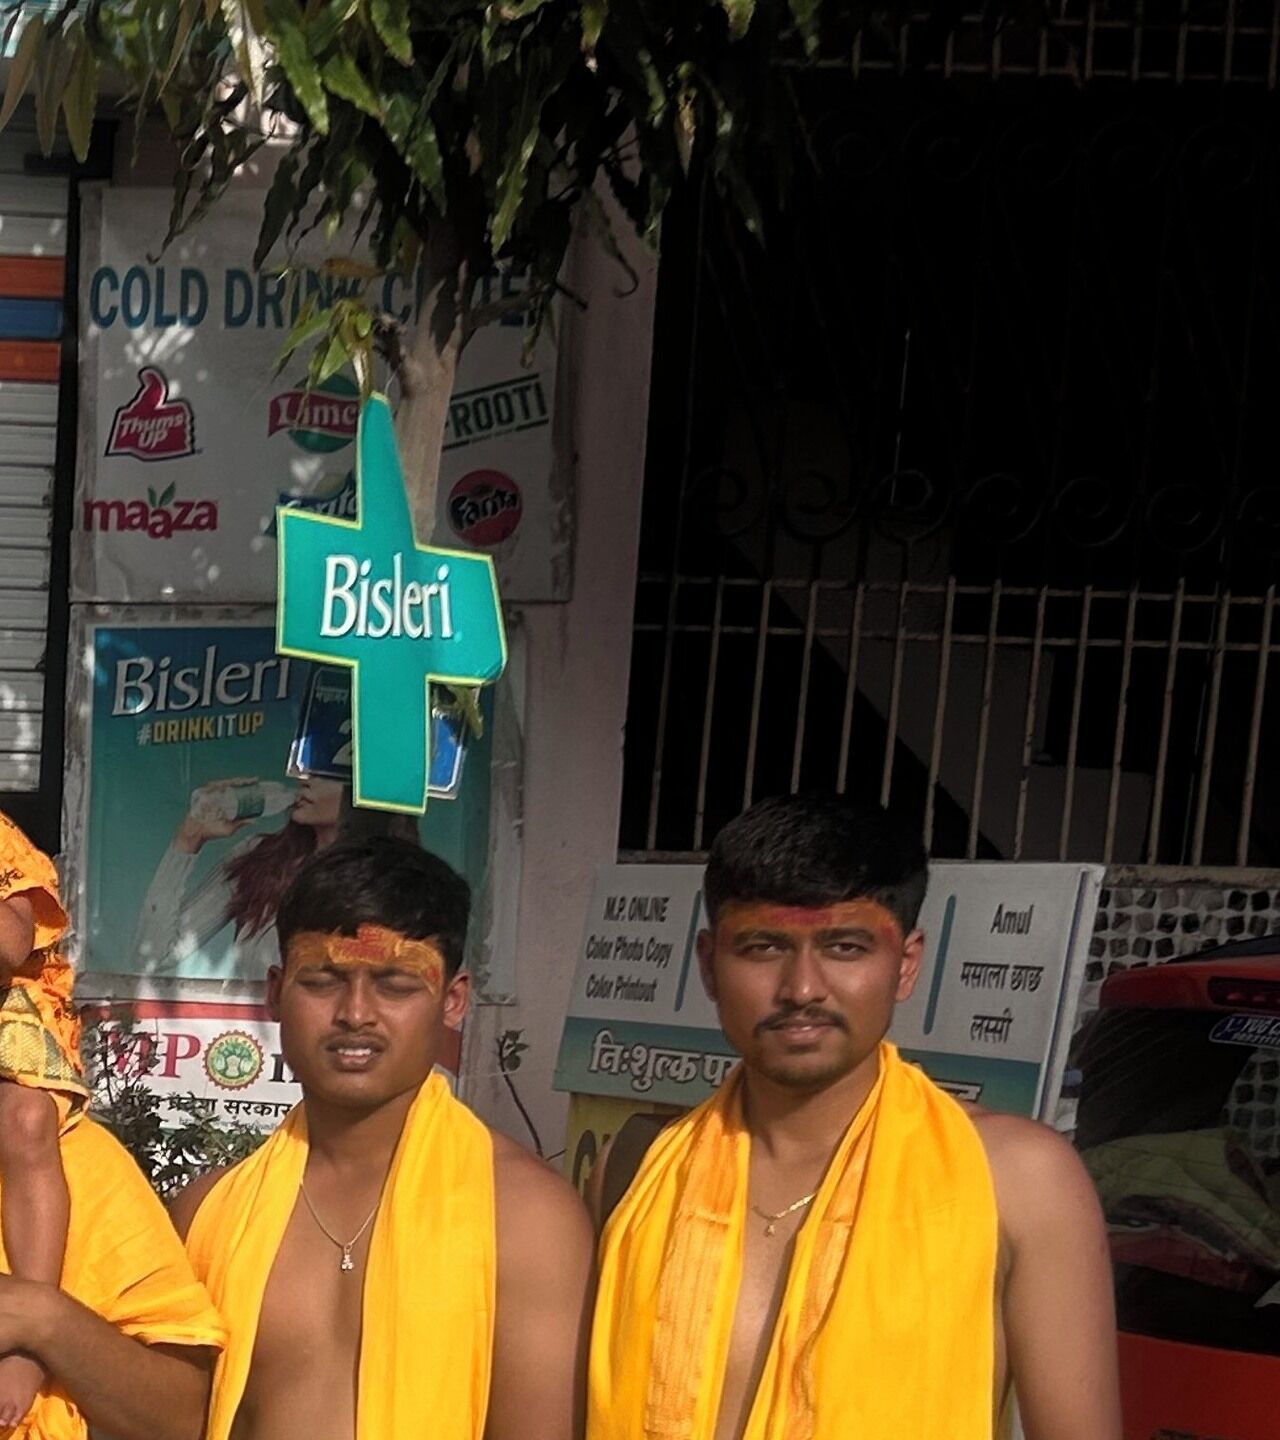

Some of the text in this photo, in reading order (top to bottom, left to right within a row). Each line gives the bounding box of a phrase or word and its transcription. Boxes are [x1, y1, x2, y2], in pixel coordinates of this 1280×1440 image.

[89, 266, 209, 329] COLD
[277, 400, 359, 427] Limc
[443, 382, 547, 440] ROOTI
[83, 498, 219, 540] maaza
[318, 552, 454, 640] Bisleri
[111, 645, 290, 717] Bisleri
[137, 711, 265, 746] #DRINKITUP
[627, 896, 671, 923] ONLINE
[990, 903, 1035, 935] Amul
[585, 935, 673, 969] Color Photo Copy
[585, 974, 613, 999] Color
[960, 962, 1045, 993] मसाला छाछ
[971, 1006, 1015, 1044] लस्सी
